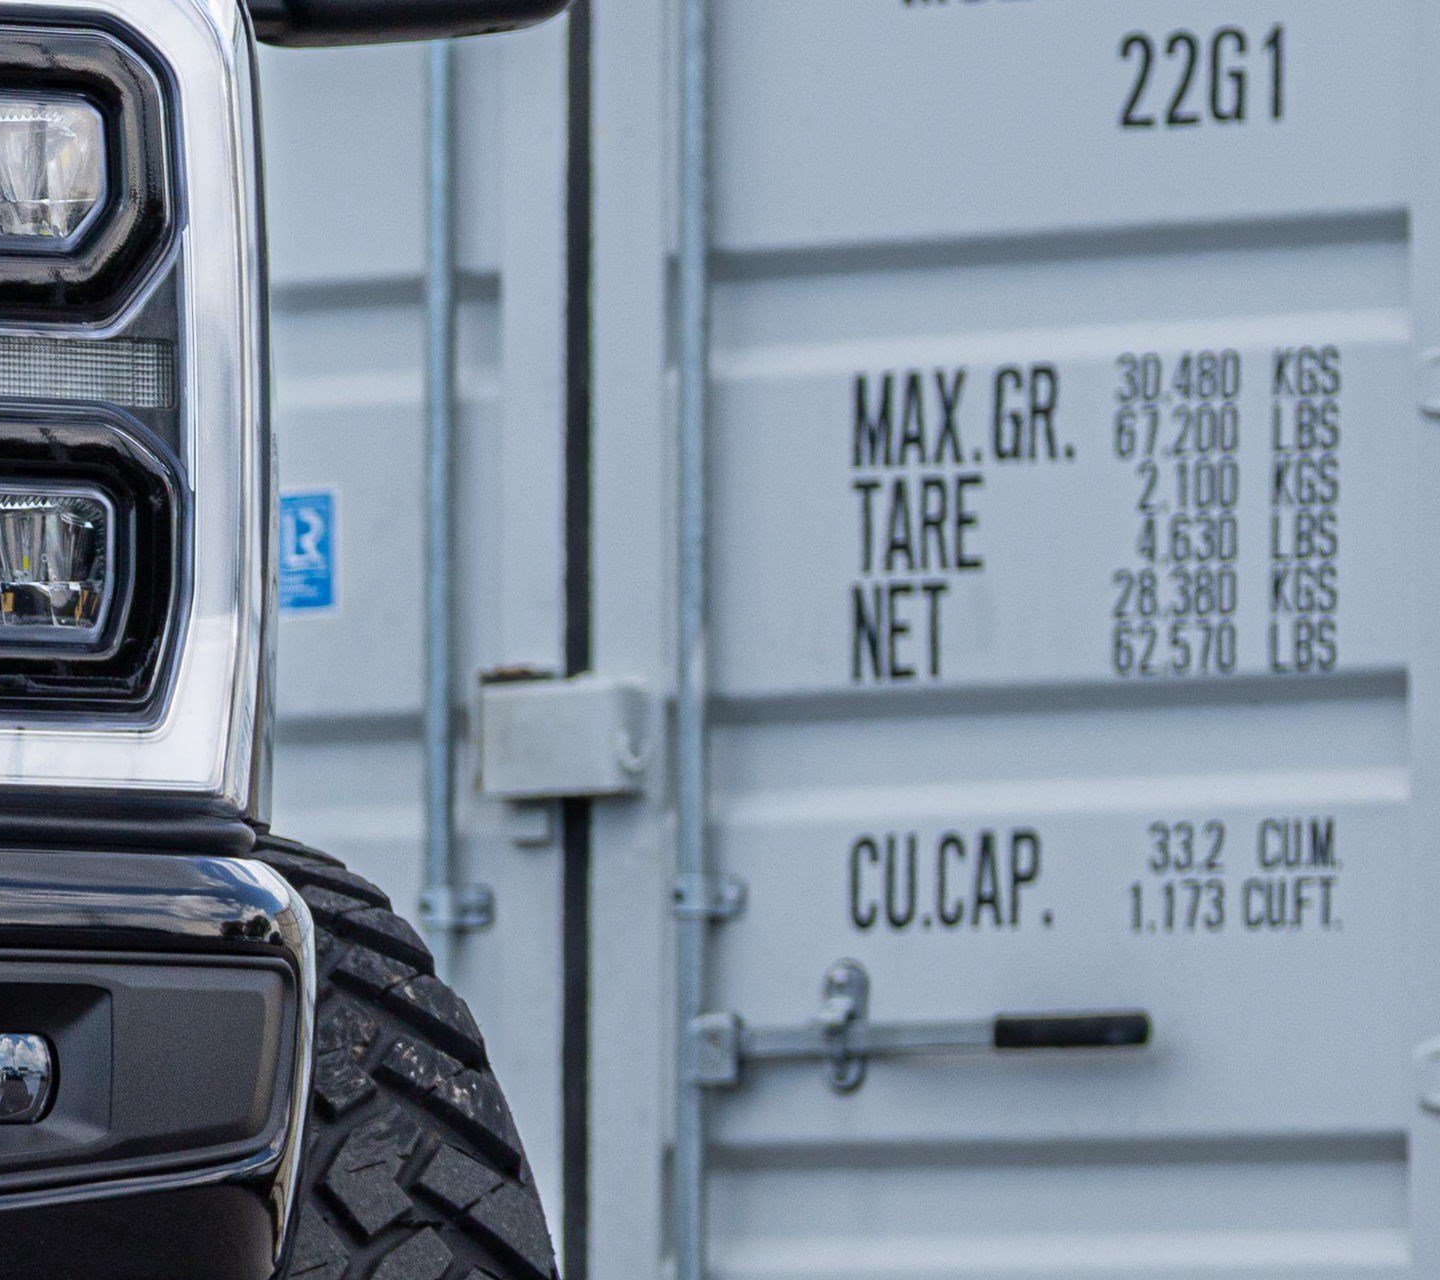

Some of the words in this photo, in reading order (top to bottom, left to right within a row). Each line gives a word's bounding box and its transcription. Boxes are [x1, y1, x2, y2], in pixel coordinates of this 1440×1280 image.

[1118, 22, 1286, 128] 22G1
[1113, 348, 1241, 404] 30.480
[1271, 345, 1341, 398] KGS
[852, 362, 1078, 468] MAX.GR.
[1113, 403, 1240, 459] 67.200
[1271, 398, 1340, 452] LBS
[1135, 457, 1240, 512] 2.100
[1271, 453, 1340, 507] KGS
[852, 472, 983, 572] TARE
[1136, 510, 1238, 565] 4.630
[1271, 507, 1339, 562] LBS
[1111, 566, 1238, 619] 28.380
[1271, 562, 1339, 614] KGS
[851, 579, 948, 682] NET
[1111, 619, 1237, 675] 62.570
[1269, 615, 1338, 672] LBS
[1147, 819, 1227, 875] 33.2
[848, 827, 1056, 931] CU.CAP.
[1128, 877, 1226, 934] 1.173
